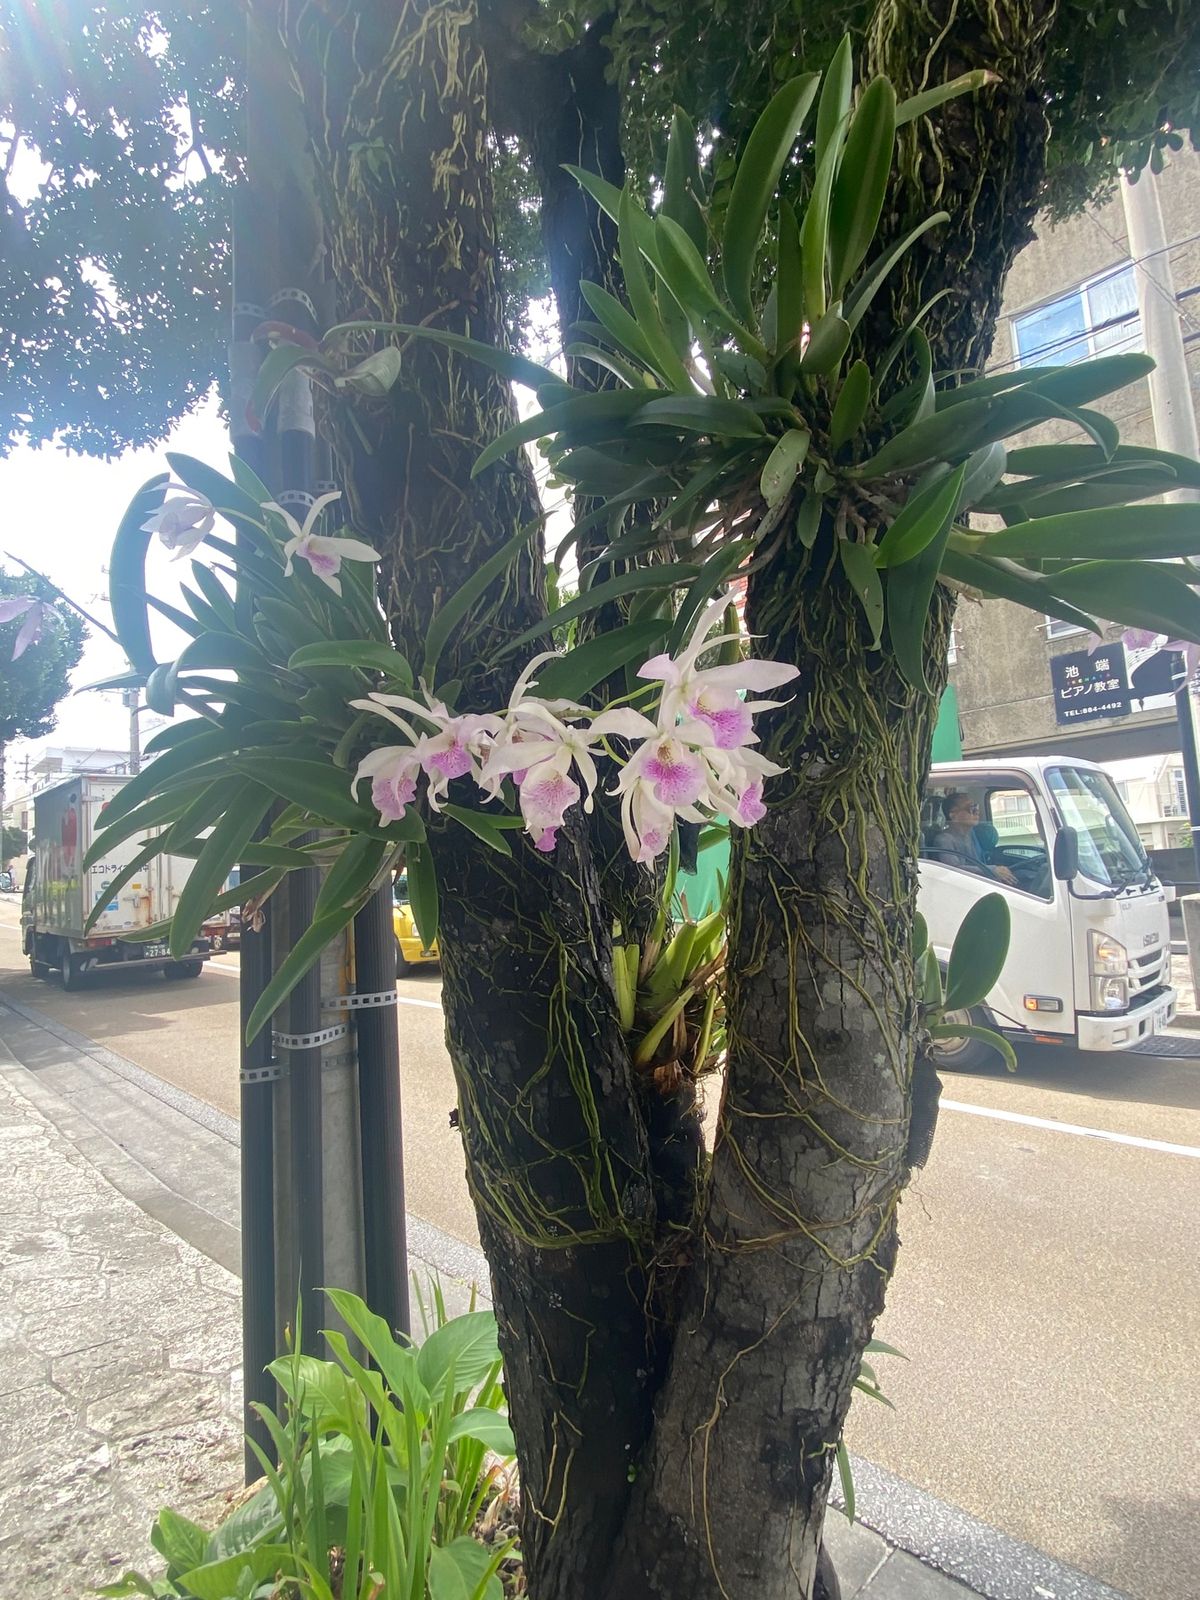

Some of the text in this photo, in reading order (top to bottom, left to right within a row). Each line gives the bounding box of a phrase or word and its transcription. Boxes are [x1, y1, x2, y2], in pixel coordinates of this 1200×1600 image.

[1060, 678, 1120, 699] ピアノ教室
